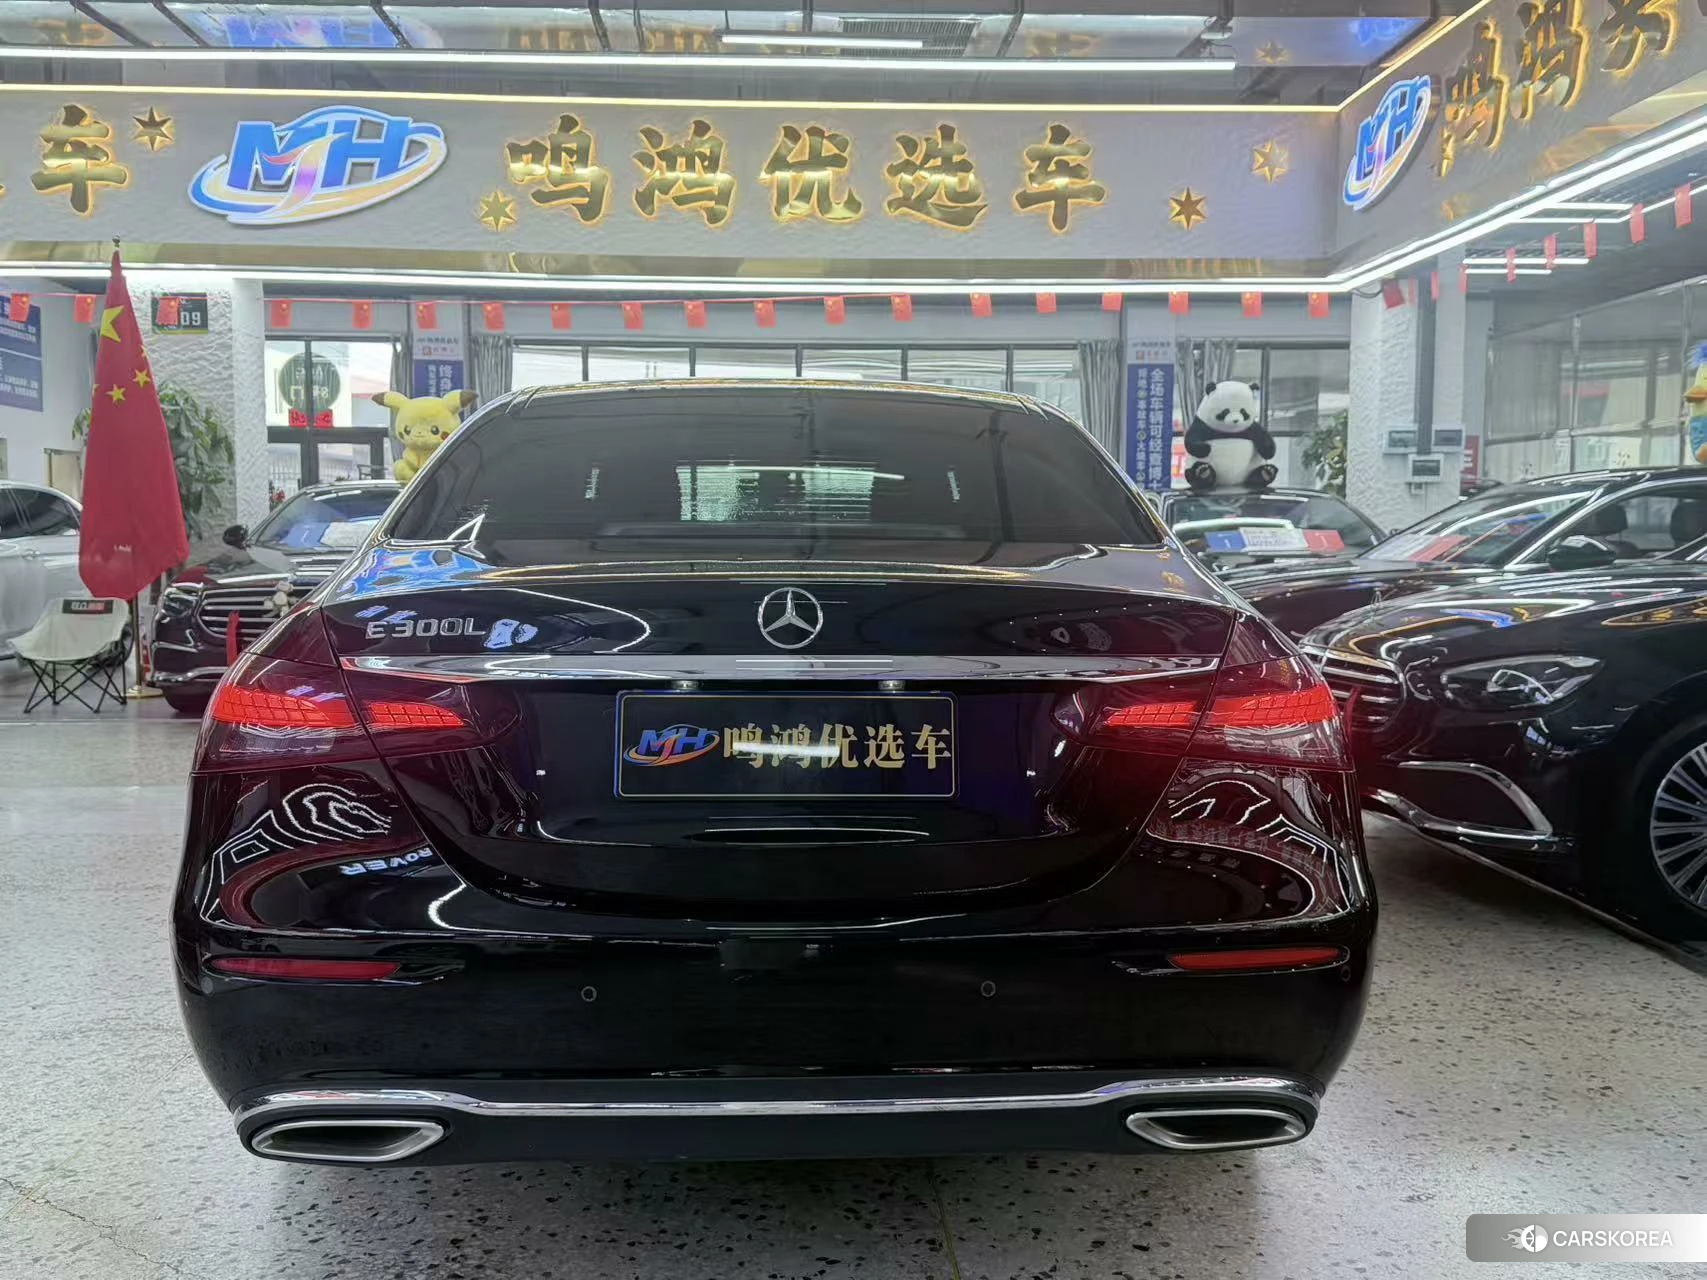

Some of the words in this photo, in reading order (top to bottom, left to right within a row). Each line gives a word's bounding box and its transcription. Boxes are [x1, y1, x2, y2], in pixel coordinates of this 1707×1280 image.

[30, 104, 129, 217] 车
[222, 110, 425, 198] MH
[506, 112, 1106, 233] 鸣鸿优选车
[723, 722, 952, 770] 鸣鸿优选车
